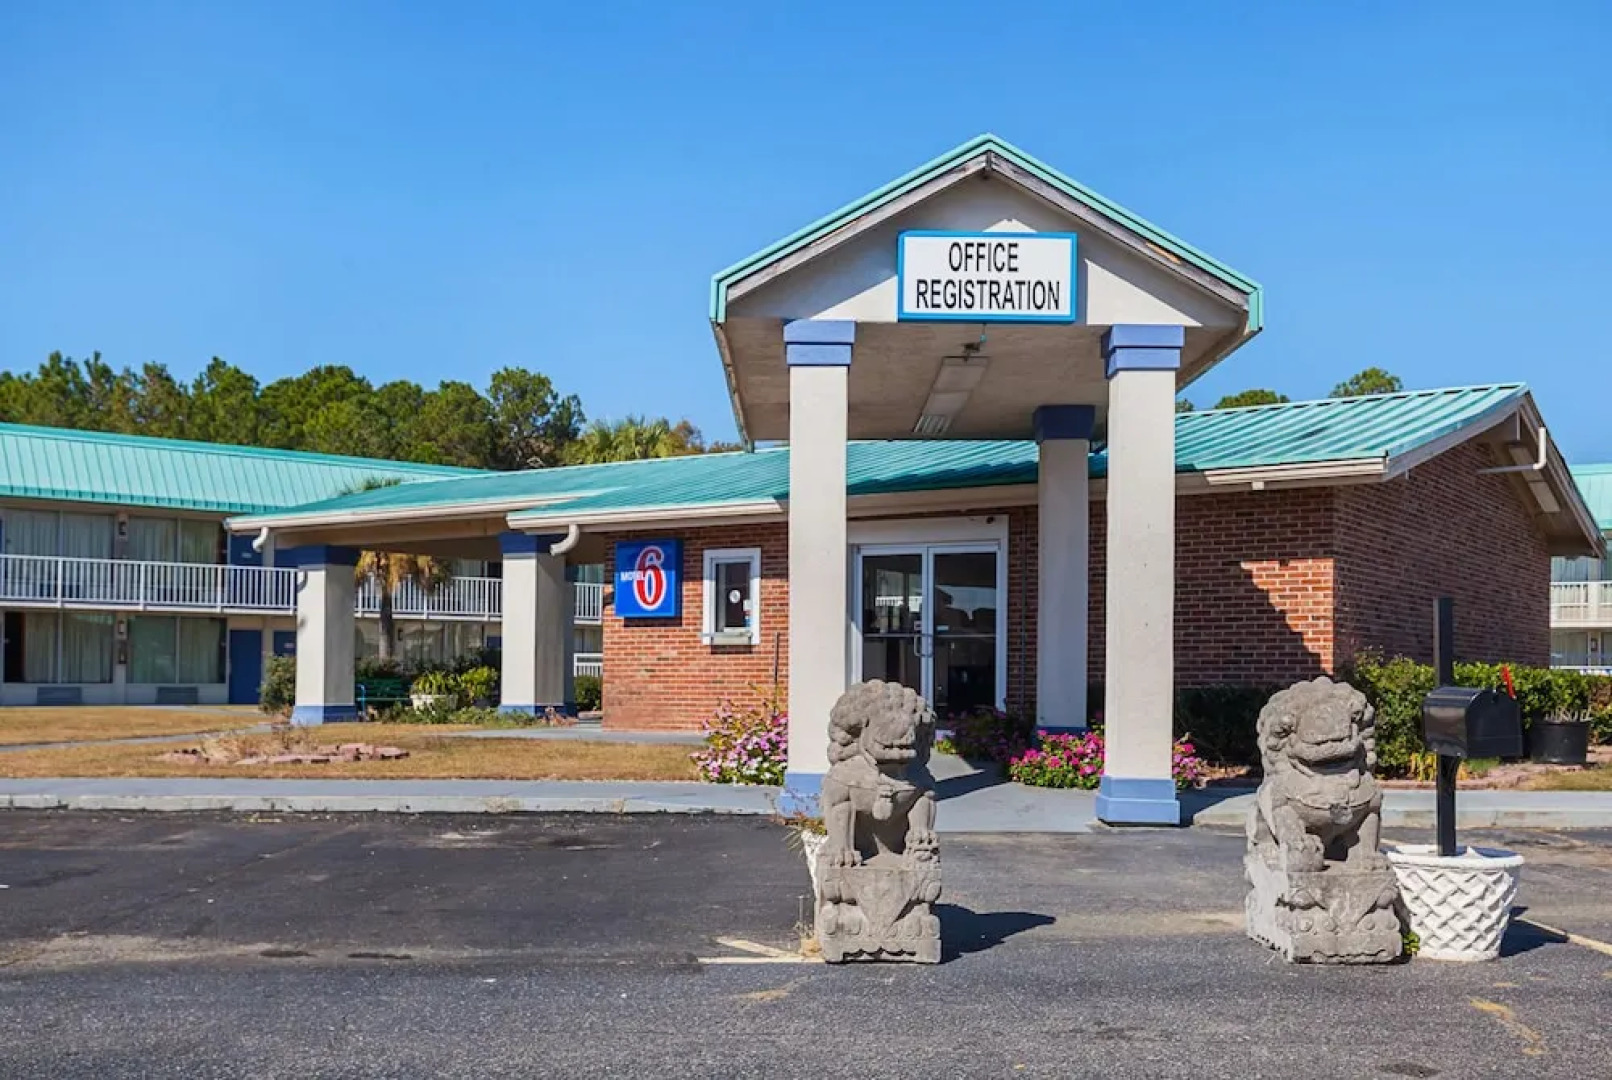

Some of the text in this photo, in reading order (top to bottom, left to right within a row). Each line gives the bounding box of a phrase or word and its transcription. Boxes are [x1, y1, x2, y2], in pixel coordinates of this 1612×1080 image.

[949, 242, 1018, 272] OFFICE
[916, 279, 1060, 310] REGISTRATION
[633, 546, 666, 611] 6
